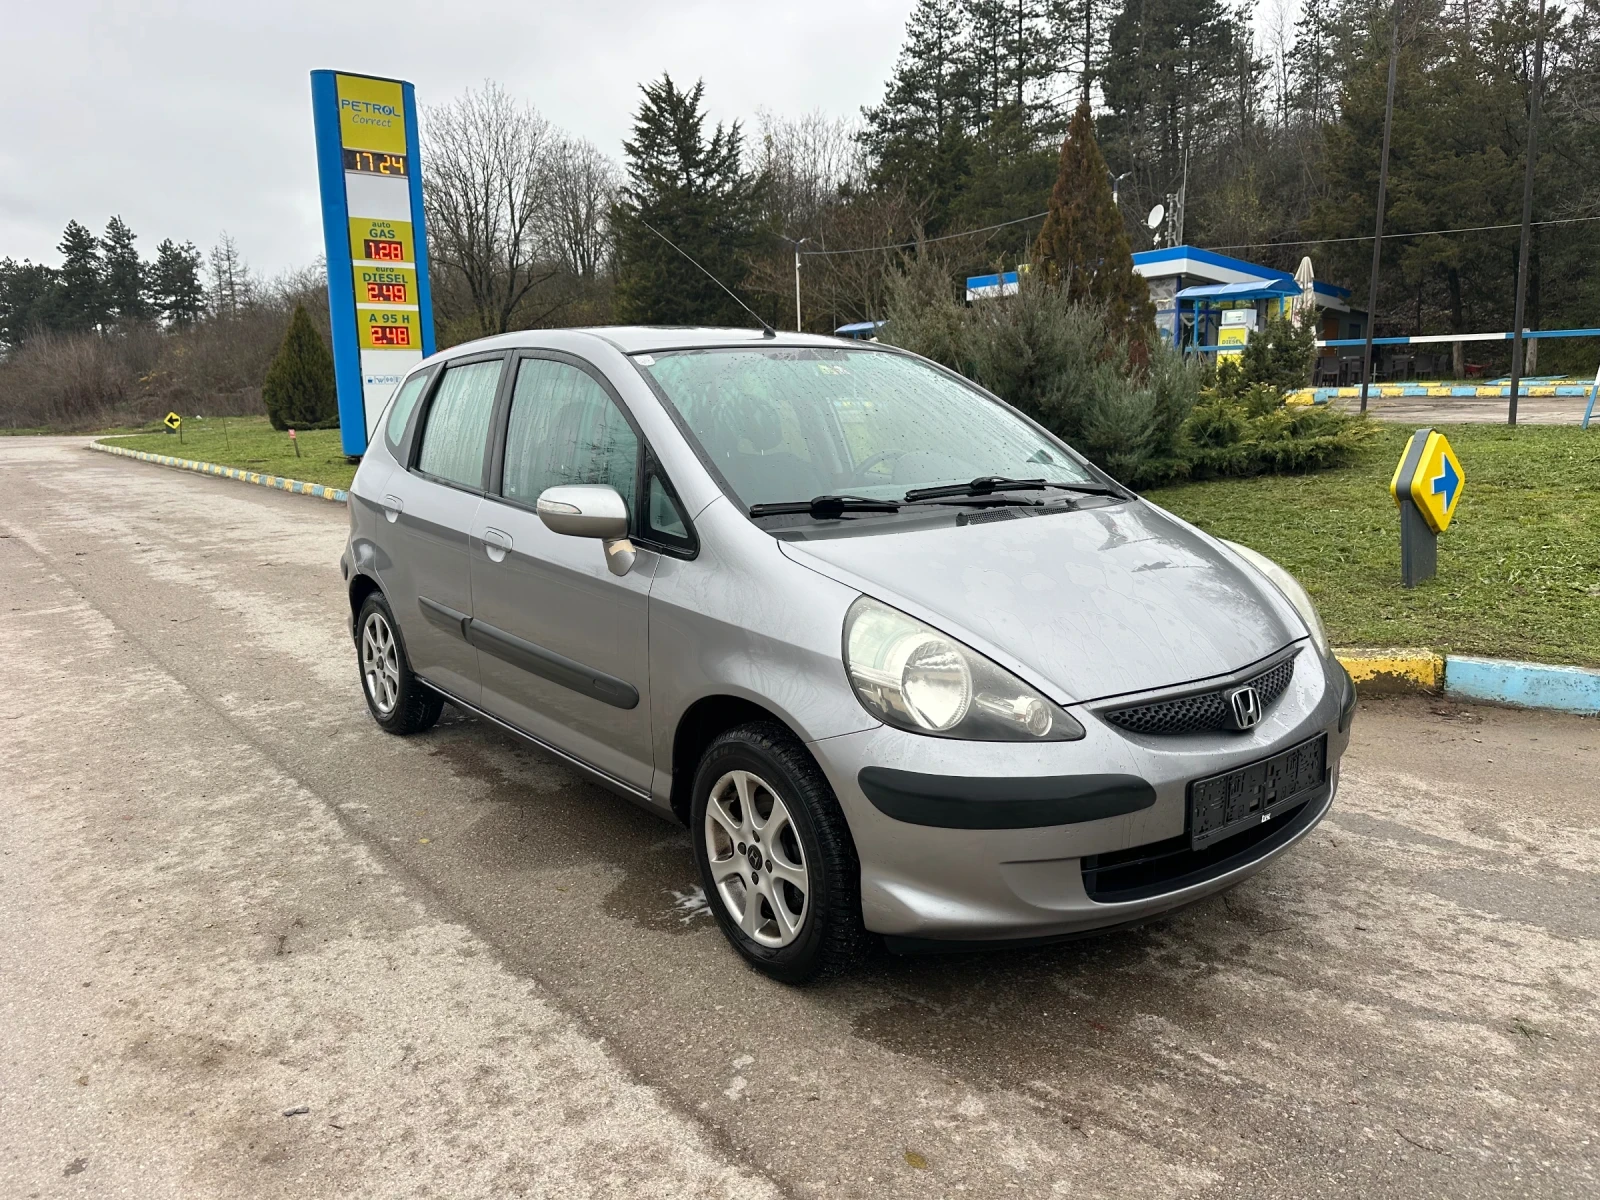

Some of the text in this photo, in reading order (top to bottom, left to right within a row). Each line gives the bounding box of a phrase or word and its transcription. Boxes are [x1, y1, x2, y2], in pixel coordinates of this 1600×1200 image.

[341, 99, 401, 117] PETROL
[352, 114, 392, 127] Correct
[371, 221, 391, 229] auto
[369, 228, 396, 239] GAS
[362, 272, 408, 284] DIESEL
[369, 313, 410, 324] A 95 H
